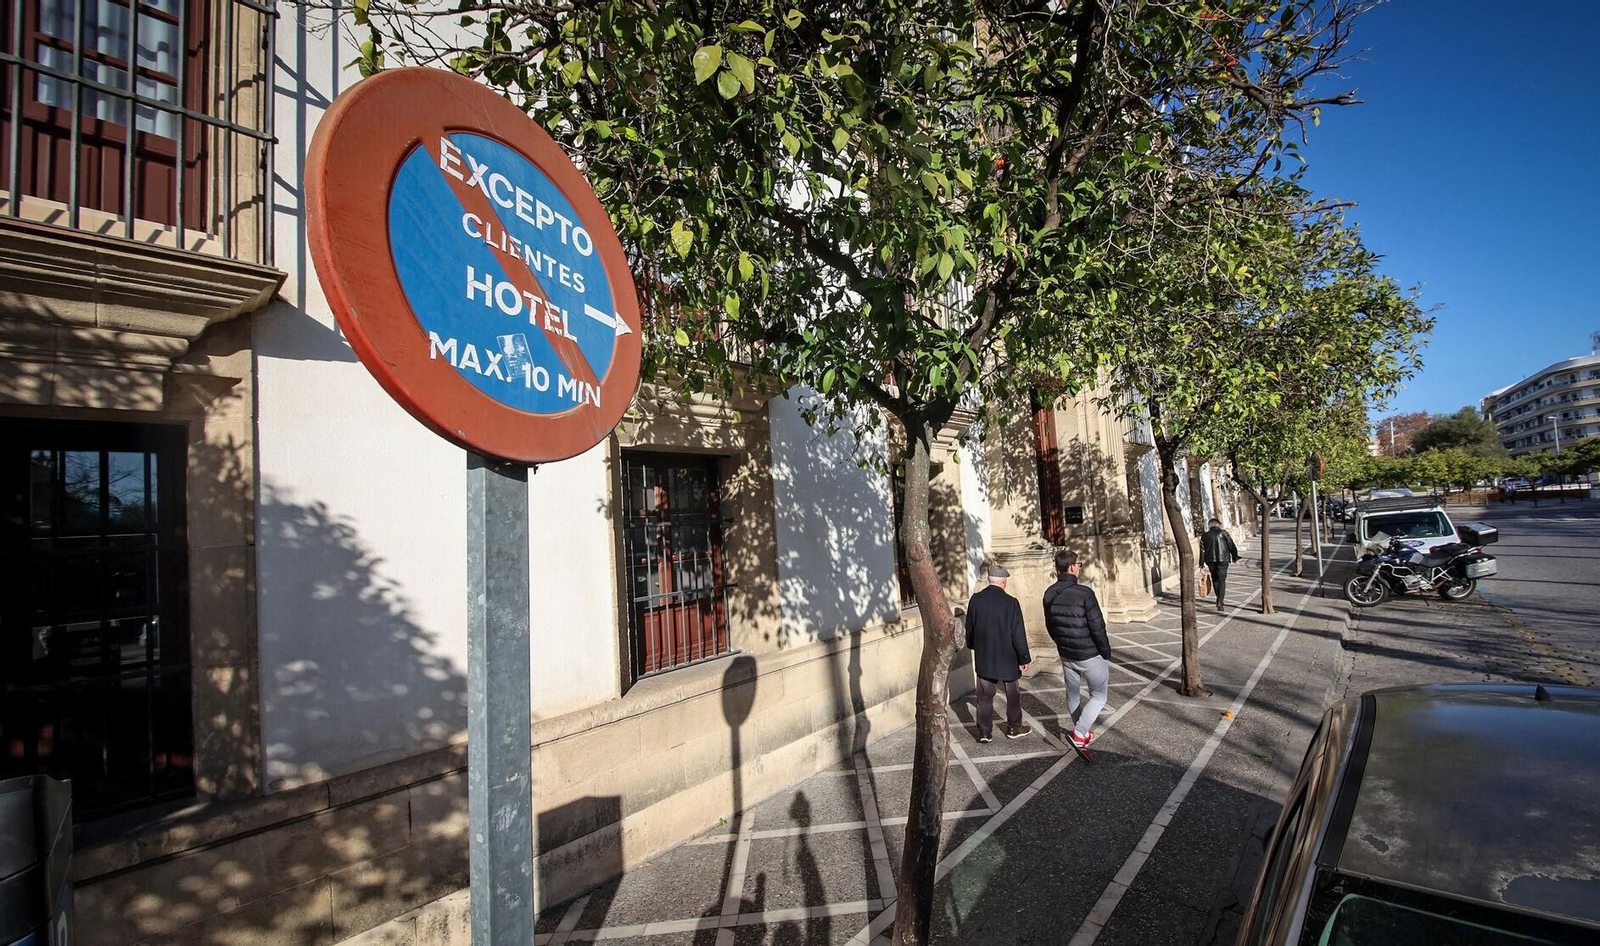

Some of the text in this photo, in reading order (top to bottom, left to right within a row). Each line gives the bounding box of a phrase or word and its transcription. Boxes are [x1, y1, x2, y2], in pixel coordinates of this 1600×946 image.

[439, 136, 593, 257] EXCEPTO
[462, 212, 585, 293] CLIENTES
[466, 265, 577, 342] HOTEL
[429, 330, 512, 382] MAX.
[521, 362, 550, 392] 10
[557, 373, 601, 408] MIN
